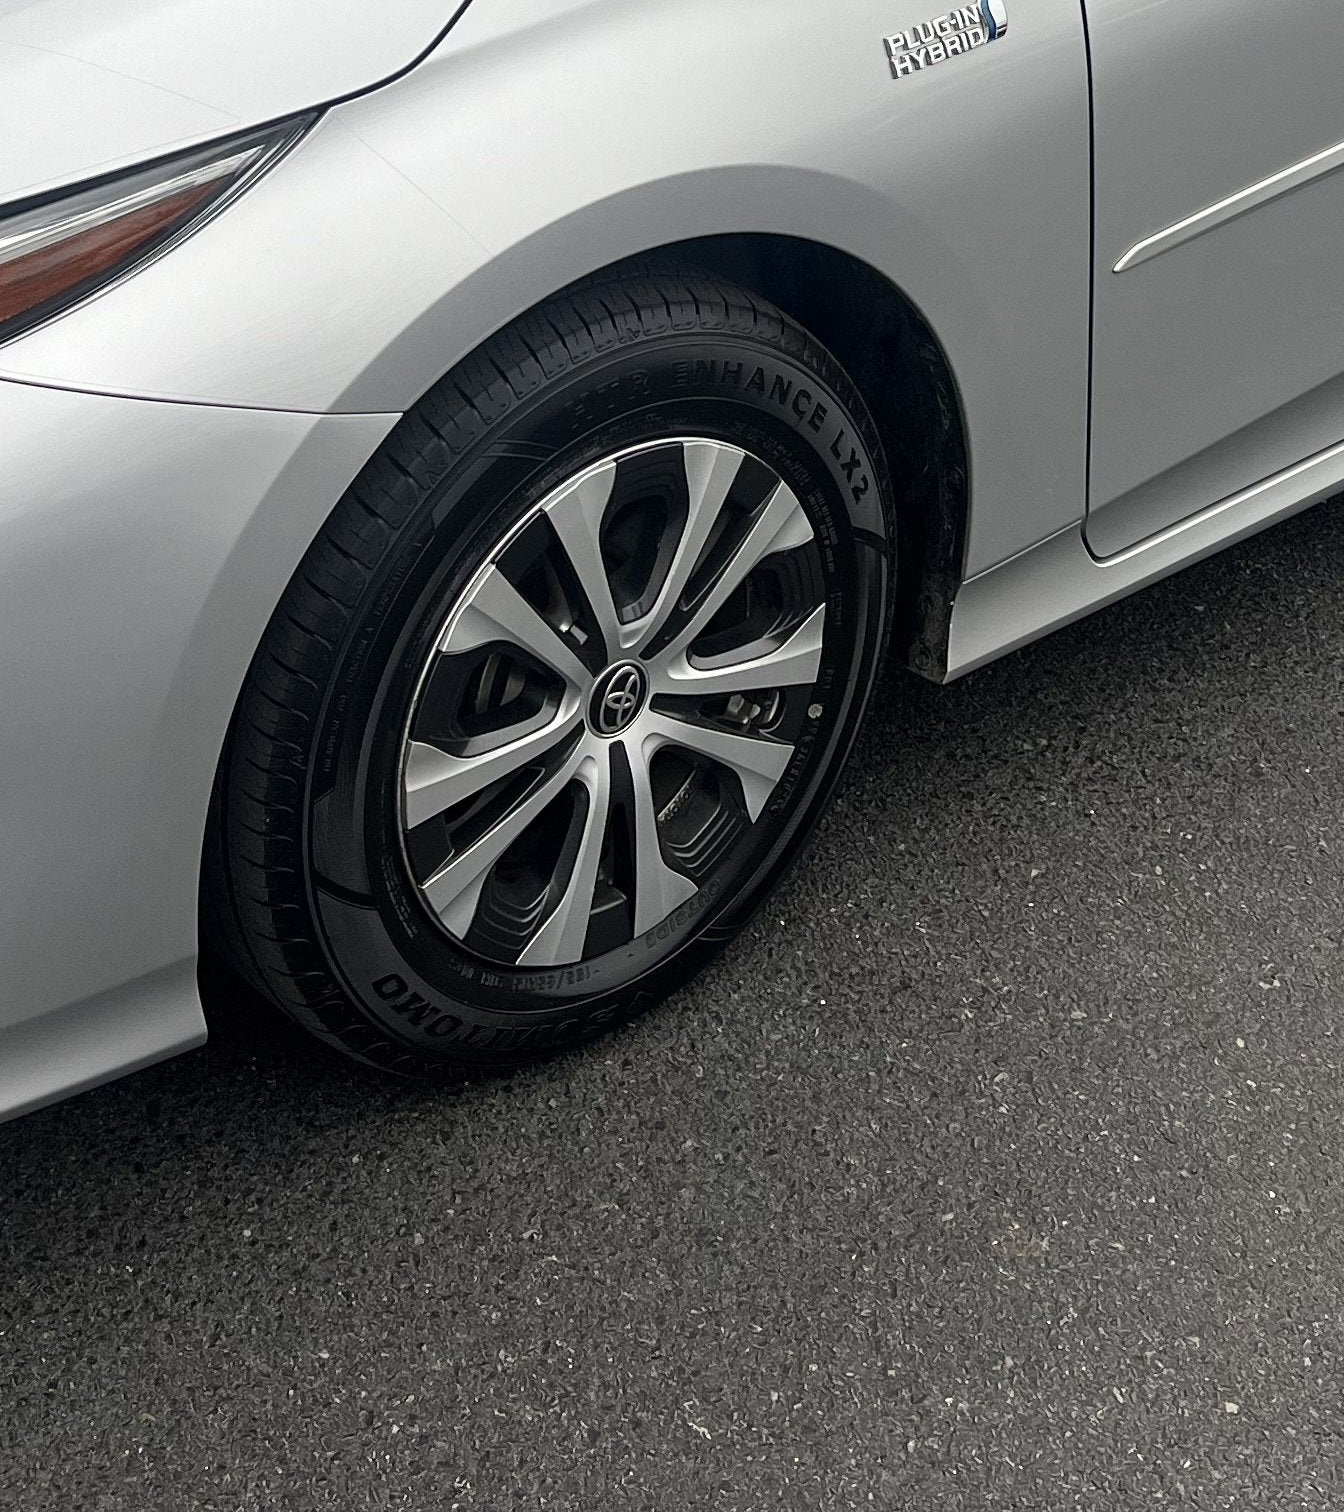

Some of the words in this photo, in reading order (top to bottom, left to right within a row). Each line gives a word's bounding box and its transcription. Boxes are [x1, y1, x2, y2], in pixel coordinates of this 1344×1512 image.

[883, 3, 981, 57] PLUG-IN
[890, 27, 985, 79] HYBRID
[670, 358, 828, 432] ENHANCE
[829, 428, 870, 506] LX2
